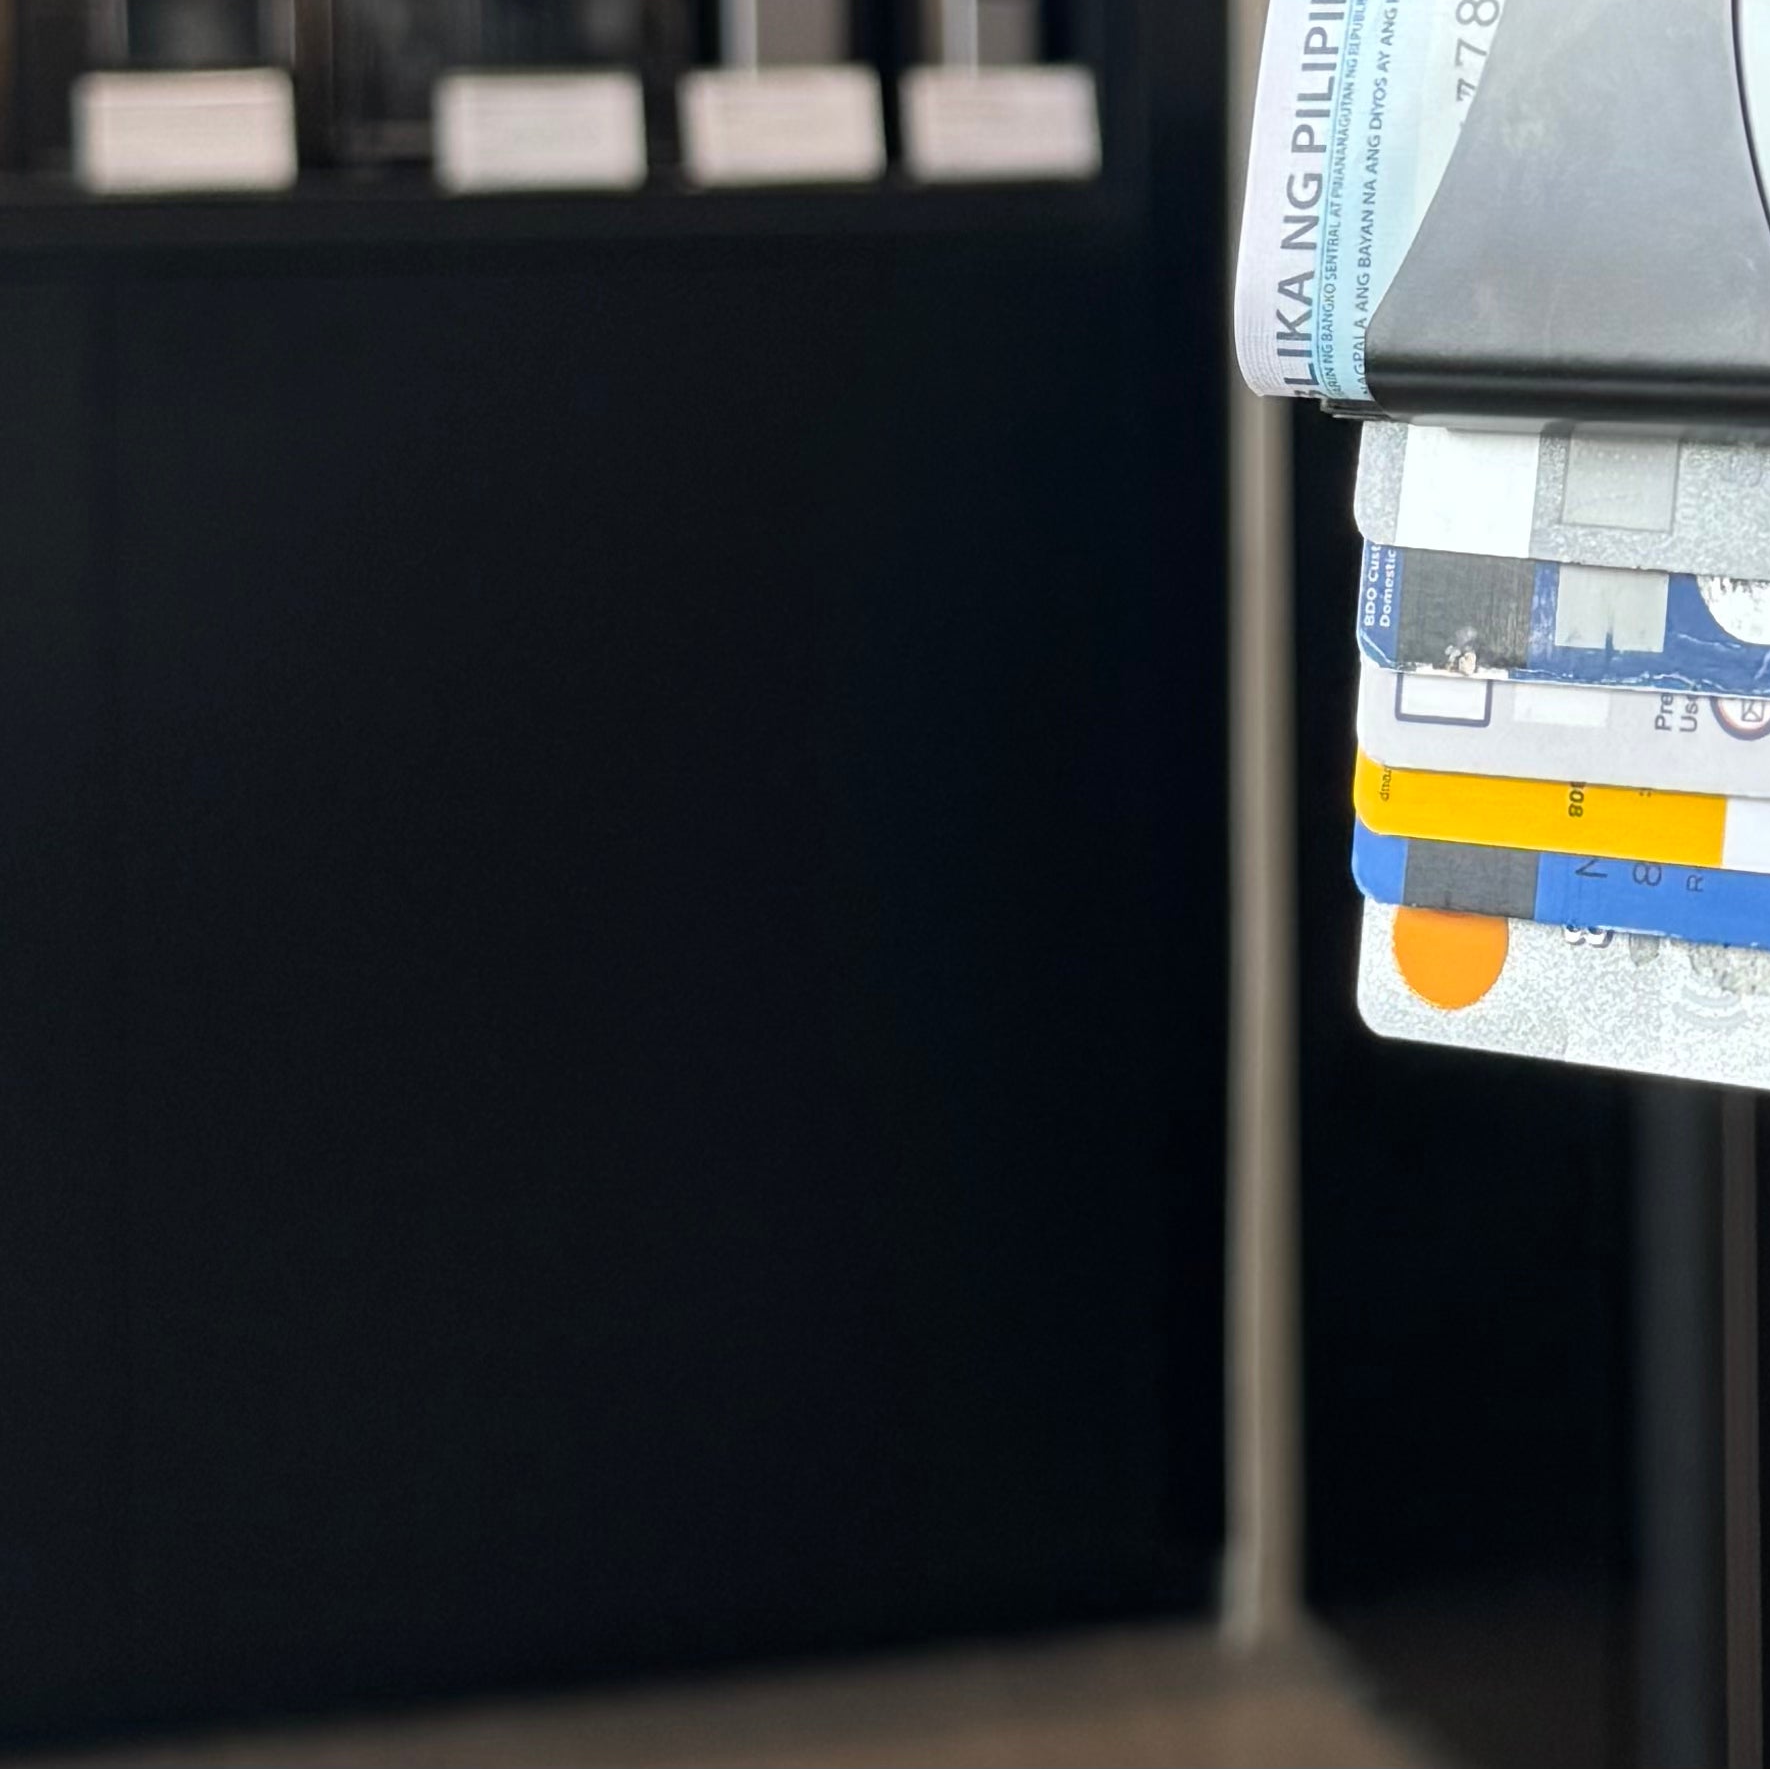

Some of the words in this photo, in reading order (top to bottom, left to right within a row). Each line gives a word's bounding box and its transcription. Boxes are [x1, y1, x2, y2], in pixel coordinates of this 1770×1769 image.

[1379, 7, 1398, 46] ANG
[1374, 49, 1391, 73] AY
[1368, 77, 1388, 130] DIYOS
[1365, 134, 1382, 176] ANG
[1279, 172, 1323, 250] NG
[1330, 200, 1344, 218] AT
[1361, 178, 1378, 206] NA
[1324, 221, 1342, 281] SENTRAL
[1358, 210, 1375, 268] BAYAN
[1320, 283, 1337, 342] BANGKO
[1354, 272, 1371, 313] ANG
[1363, 587, 1378, 627] BDO
[1379, 549, 1397, 628] Domestic
